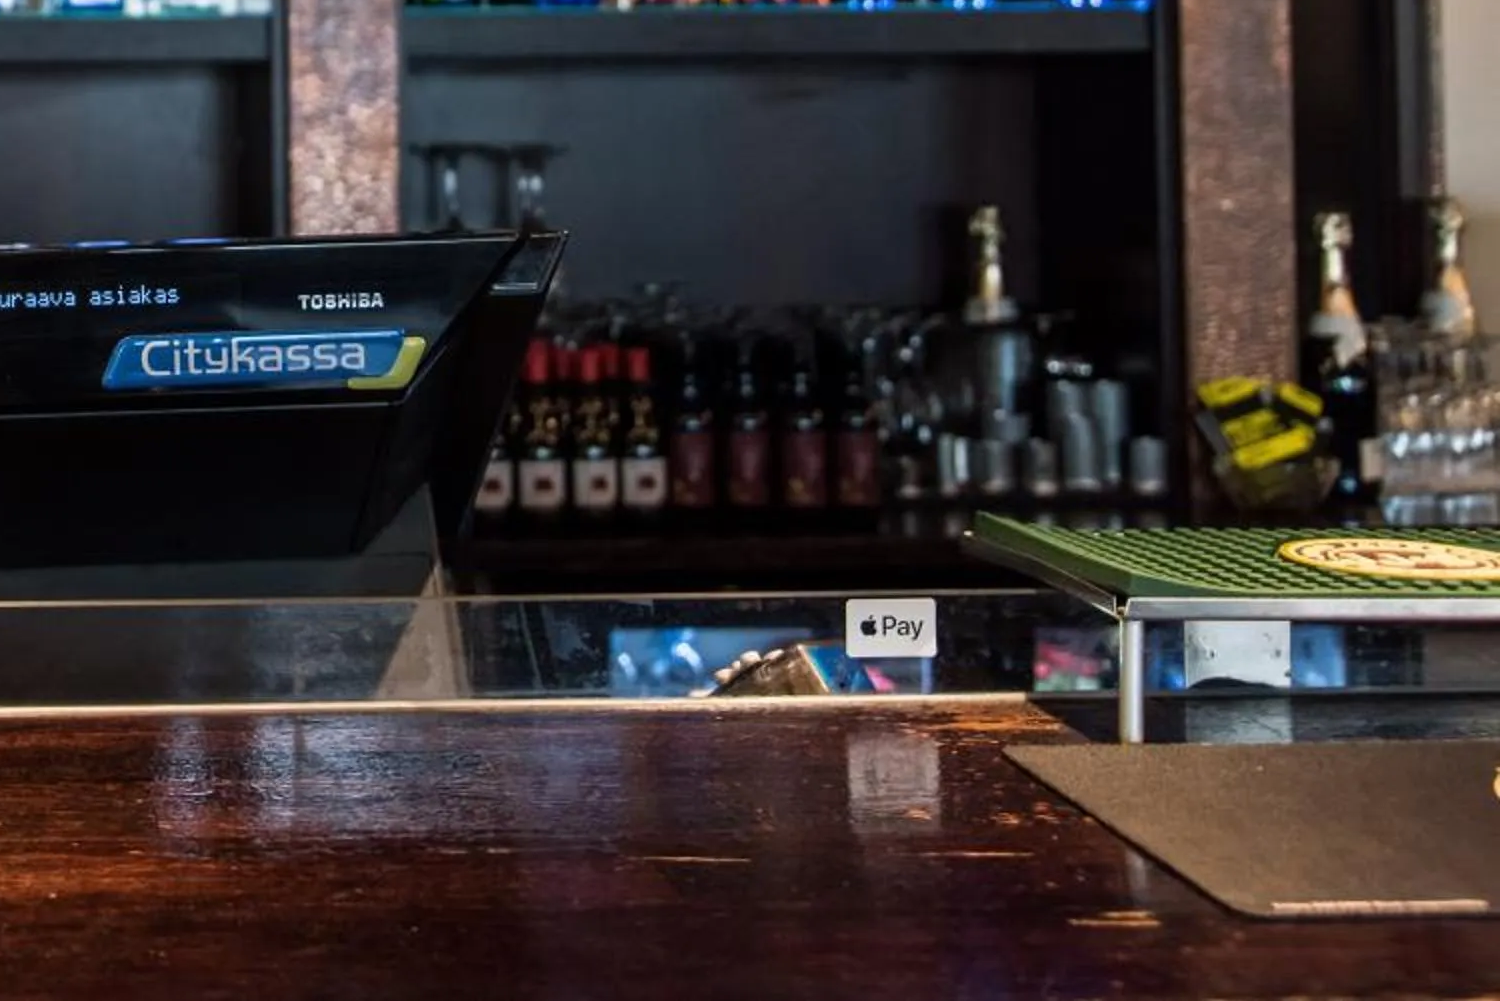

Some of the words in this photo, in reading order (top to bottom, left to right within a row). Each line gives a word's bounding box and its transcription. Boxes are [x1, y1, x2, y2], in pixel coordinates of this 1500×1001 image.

[88, 285, 180, 307] asiakas
[297, 293, 384, 309] TOSHIBA
[140, 335, 366, 378] Citykassa
[882, 615, 923, 640] Pay
